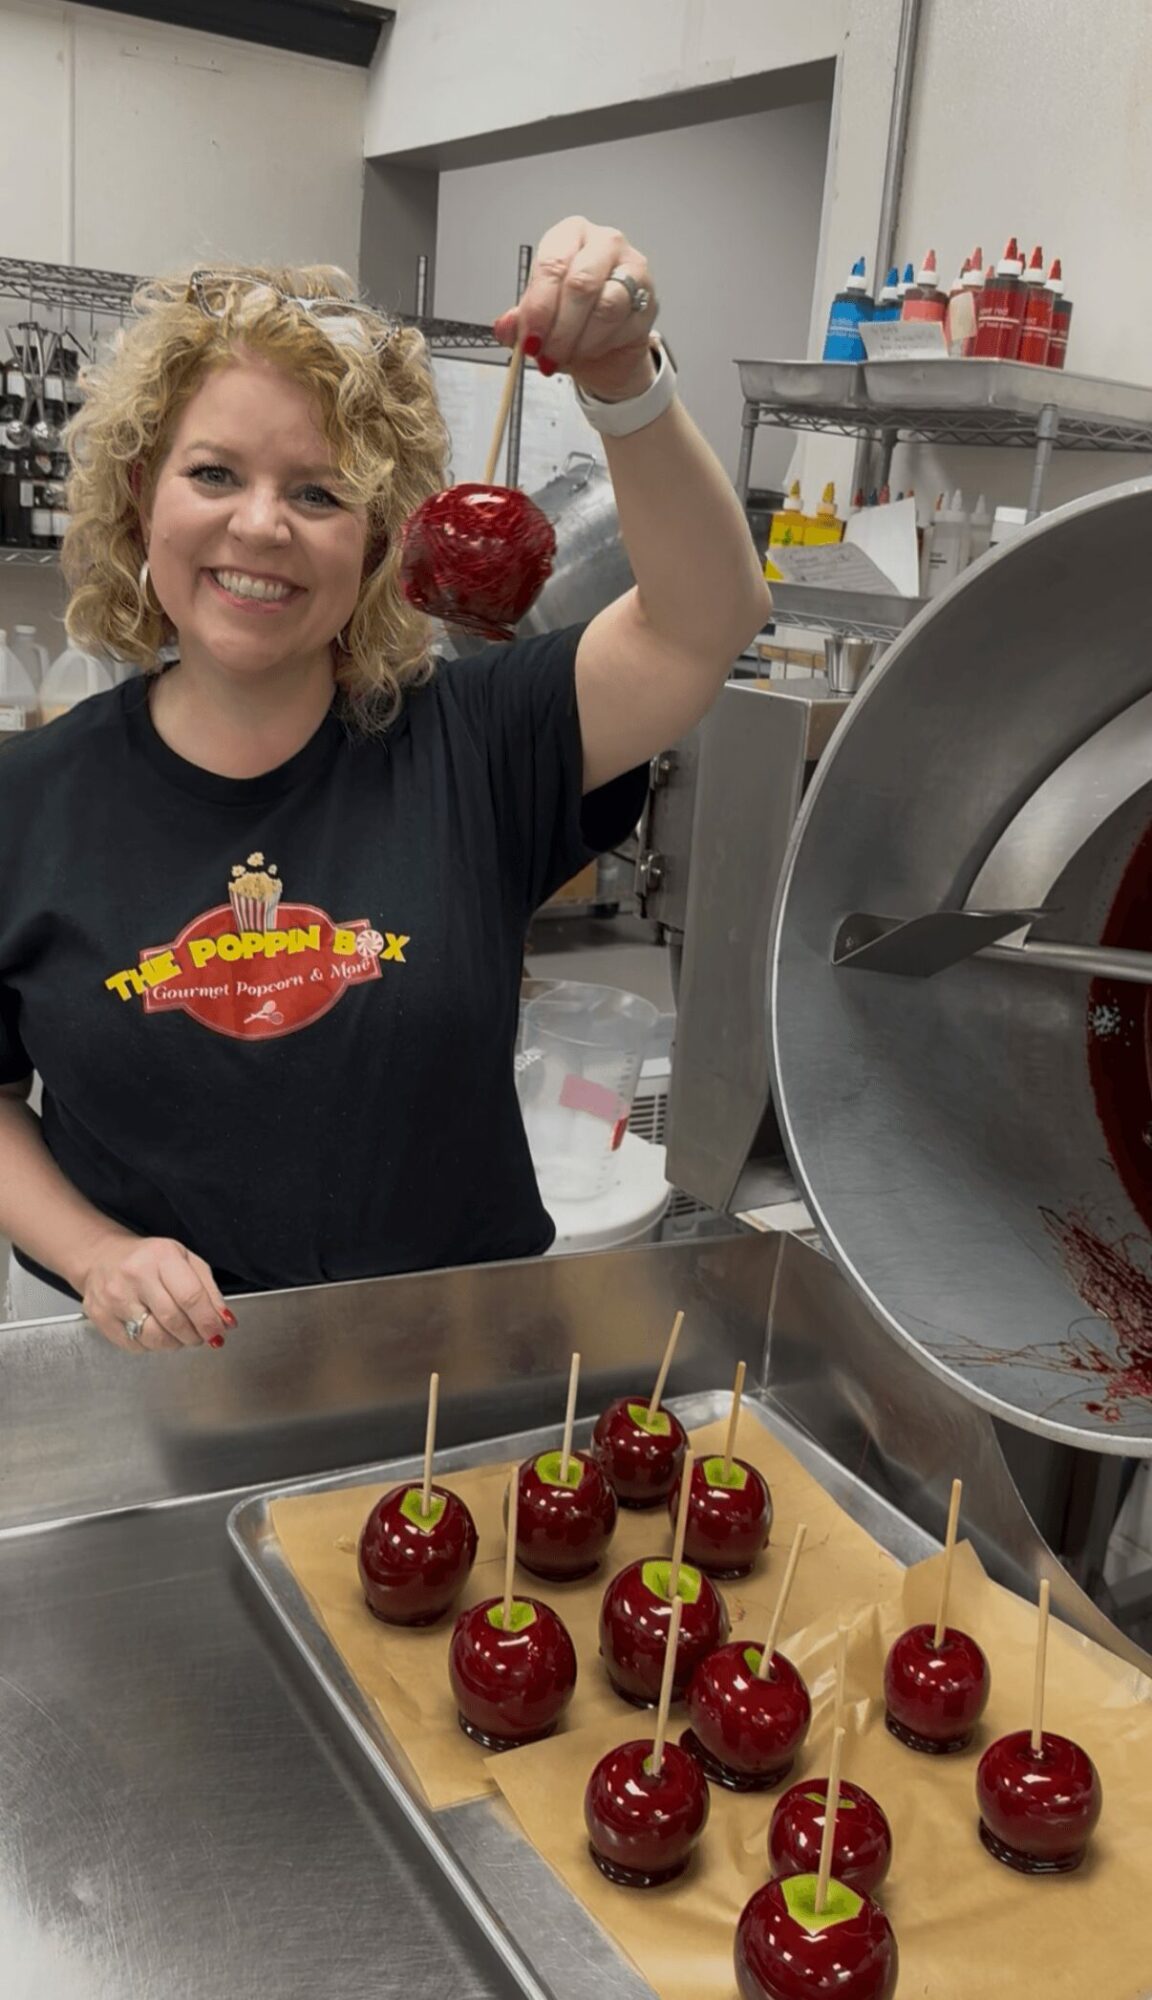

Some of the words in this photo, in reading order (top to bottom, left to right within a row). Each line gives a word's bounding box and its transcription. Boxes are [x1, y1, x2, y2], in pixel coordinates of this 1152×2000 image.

[105, 950, 183, 1002] THE
[189, 925, 321, 968] POPPIN
[152, 985, 230, 1001] Gourmet
[236, 975, 304, 996] Popcorn
[310, 968, 324, 981] &
[330, 959, 371, 979] More
